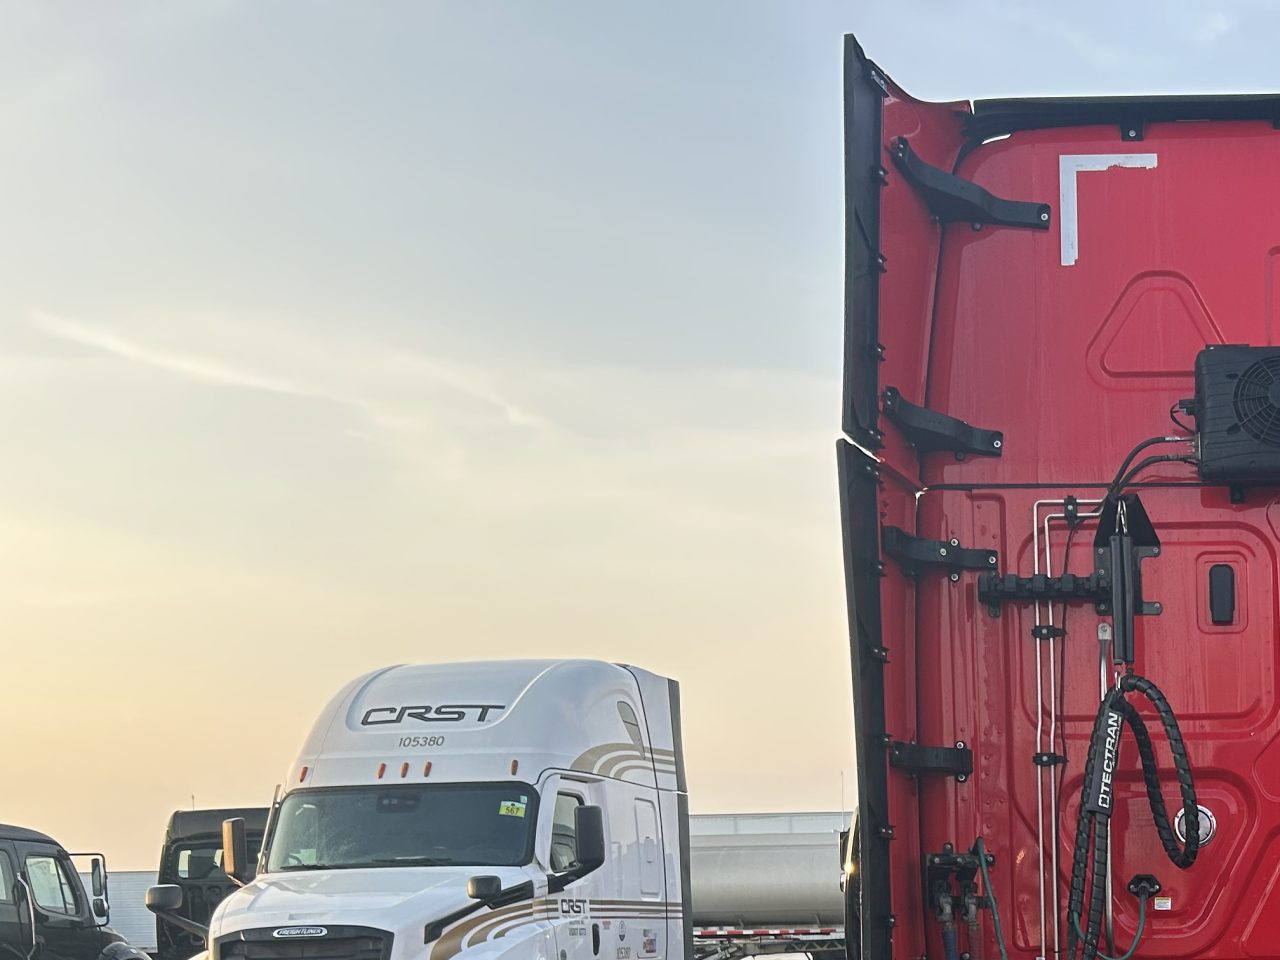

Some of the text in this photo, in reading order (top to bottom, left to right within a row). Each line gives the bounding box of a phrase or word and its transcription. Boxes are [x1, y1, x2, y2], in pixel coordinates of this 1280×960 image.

[361, 704, 506, 726] CRST
[399, 735, 445, 748] 105380
[1100, 712, 1119, 795] TECTRAN
[505, 806, 520, 815] 567
[560, 899, 587, 914] CRST
